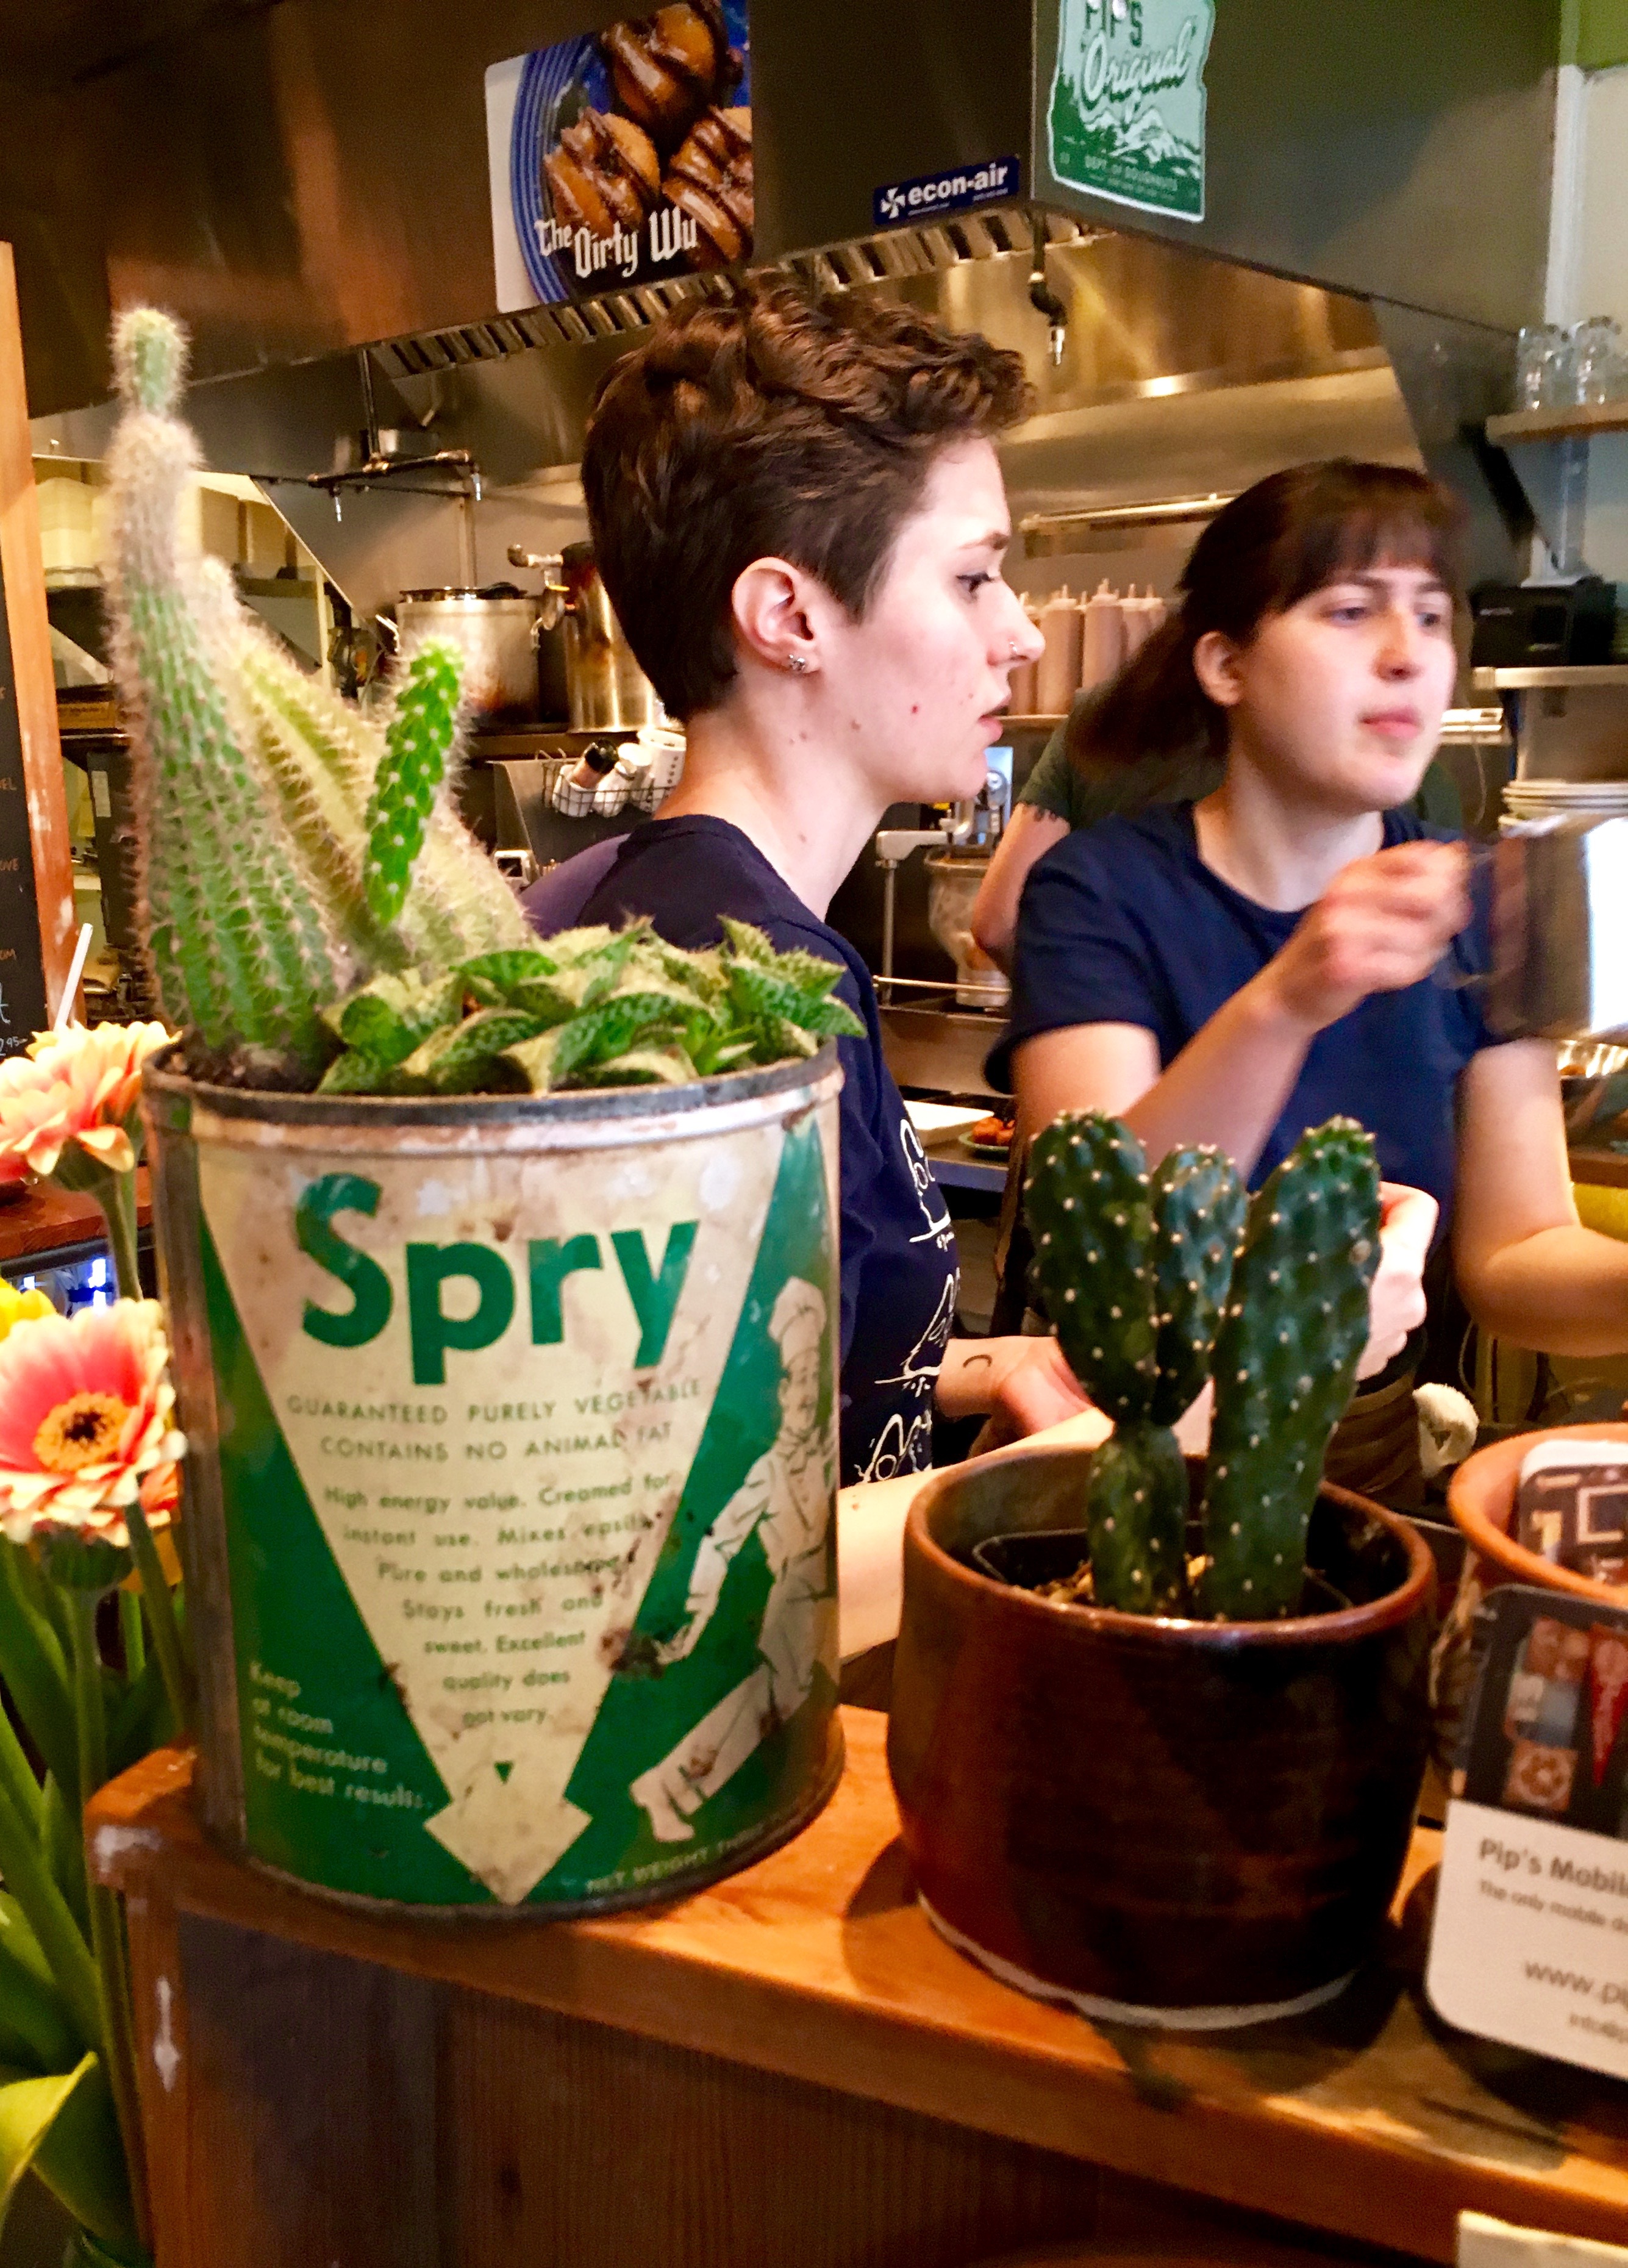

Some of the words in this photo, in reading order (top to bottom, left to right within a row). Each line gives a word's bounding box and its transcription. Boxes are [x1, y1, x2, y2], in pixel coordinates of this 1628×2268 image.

[907, 162, 1009, 206] econ-air
[535, 217, 572, 257] The
[574, 220, 638, 278] Dirty
[296, 1172, 701, 1386] Spry
[287, 1395, 448, 1425] GUARANTEED
[467, 1401, 556, 1423] PURELY
[574, 1378, 700, 1414] VEGETABLE
[320, 1435, 449, 1461] CONTAINS
[466, 1440, 507, 1459] NO
[324, 1486, 367, 1510] High
[379, 1496, 452, 1515] energy
[538, 1476, 632, 1506] Creamed
[342, 1525, 415, 1545] instant
[497, 1527, 566, 1544] Mixes
[439, 1565, 482, 1583] and
[403, 1598, 464, 1623] Stays
[485, 1597, 541, 1617] fresh
[495, 1631, 586, 1653] Excellent
[1479, 1838, 1542, 1875] Pip's
[1550, 1856, 1628, 1898] Mobil
